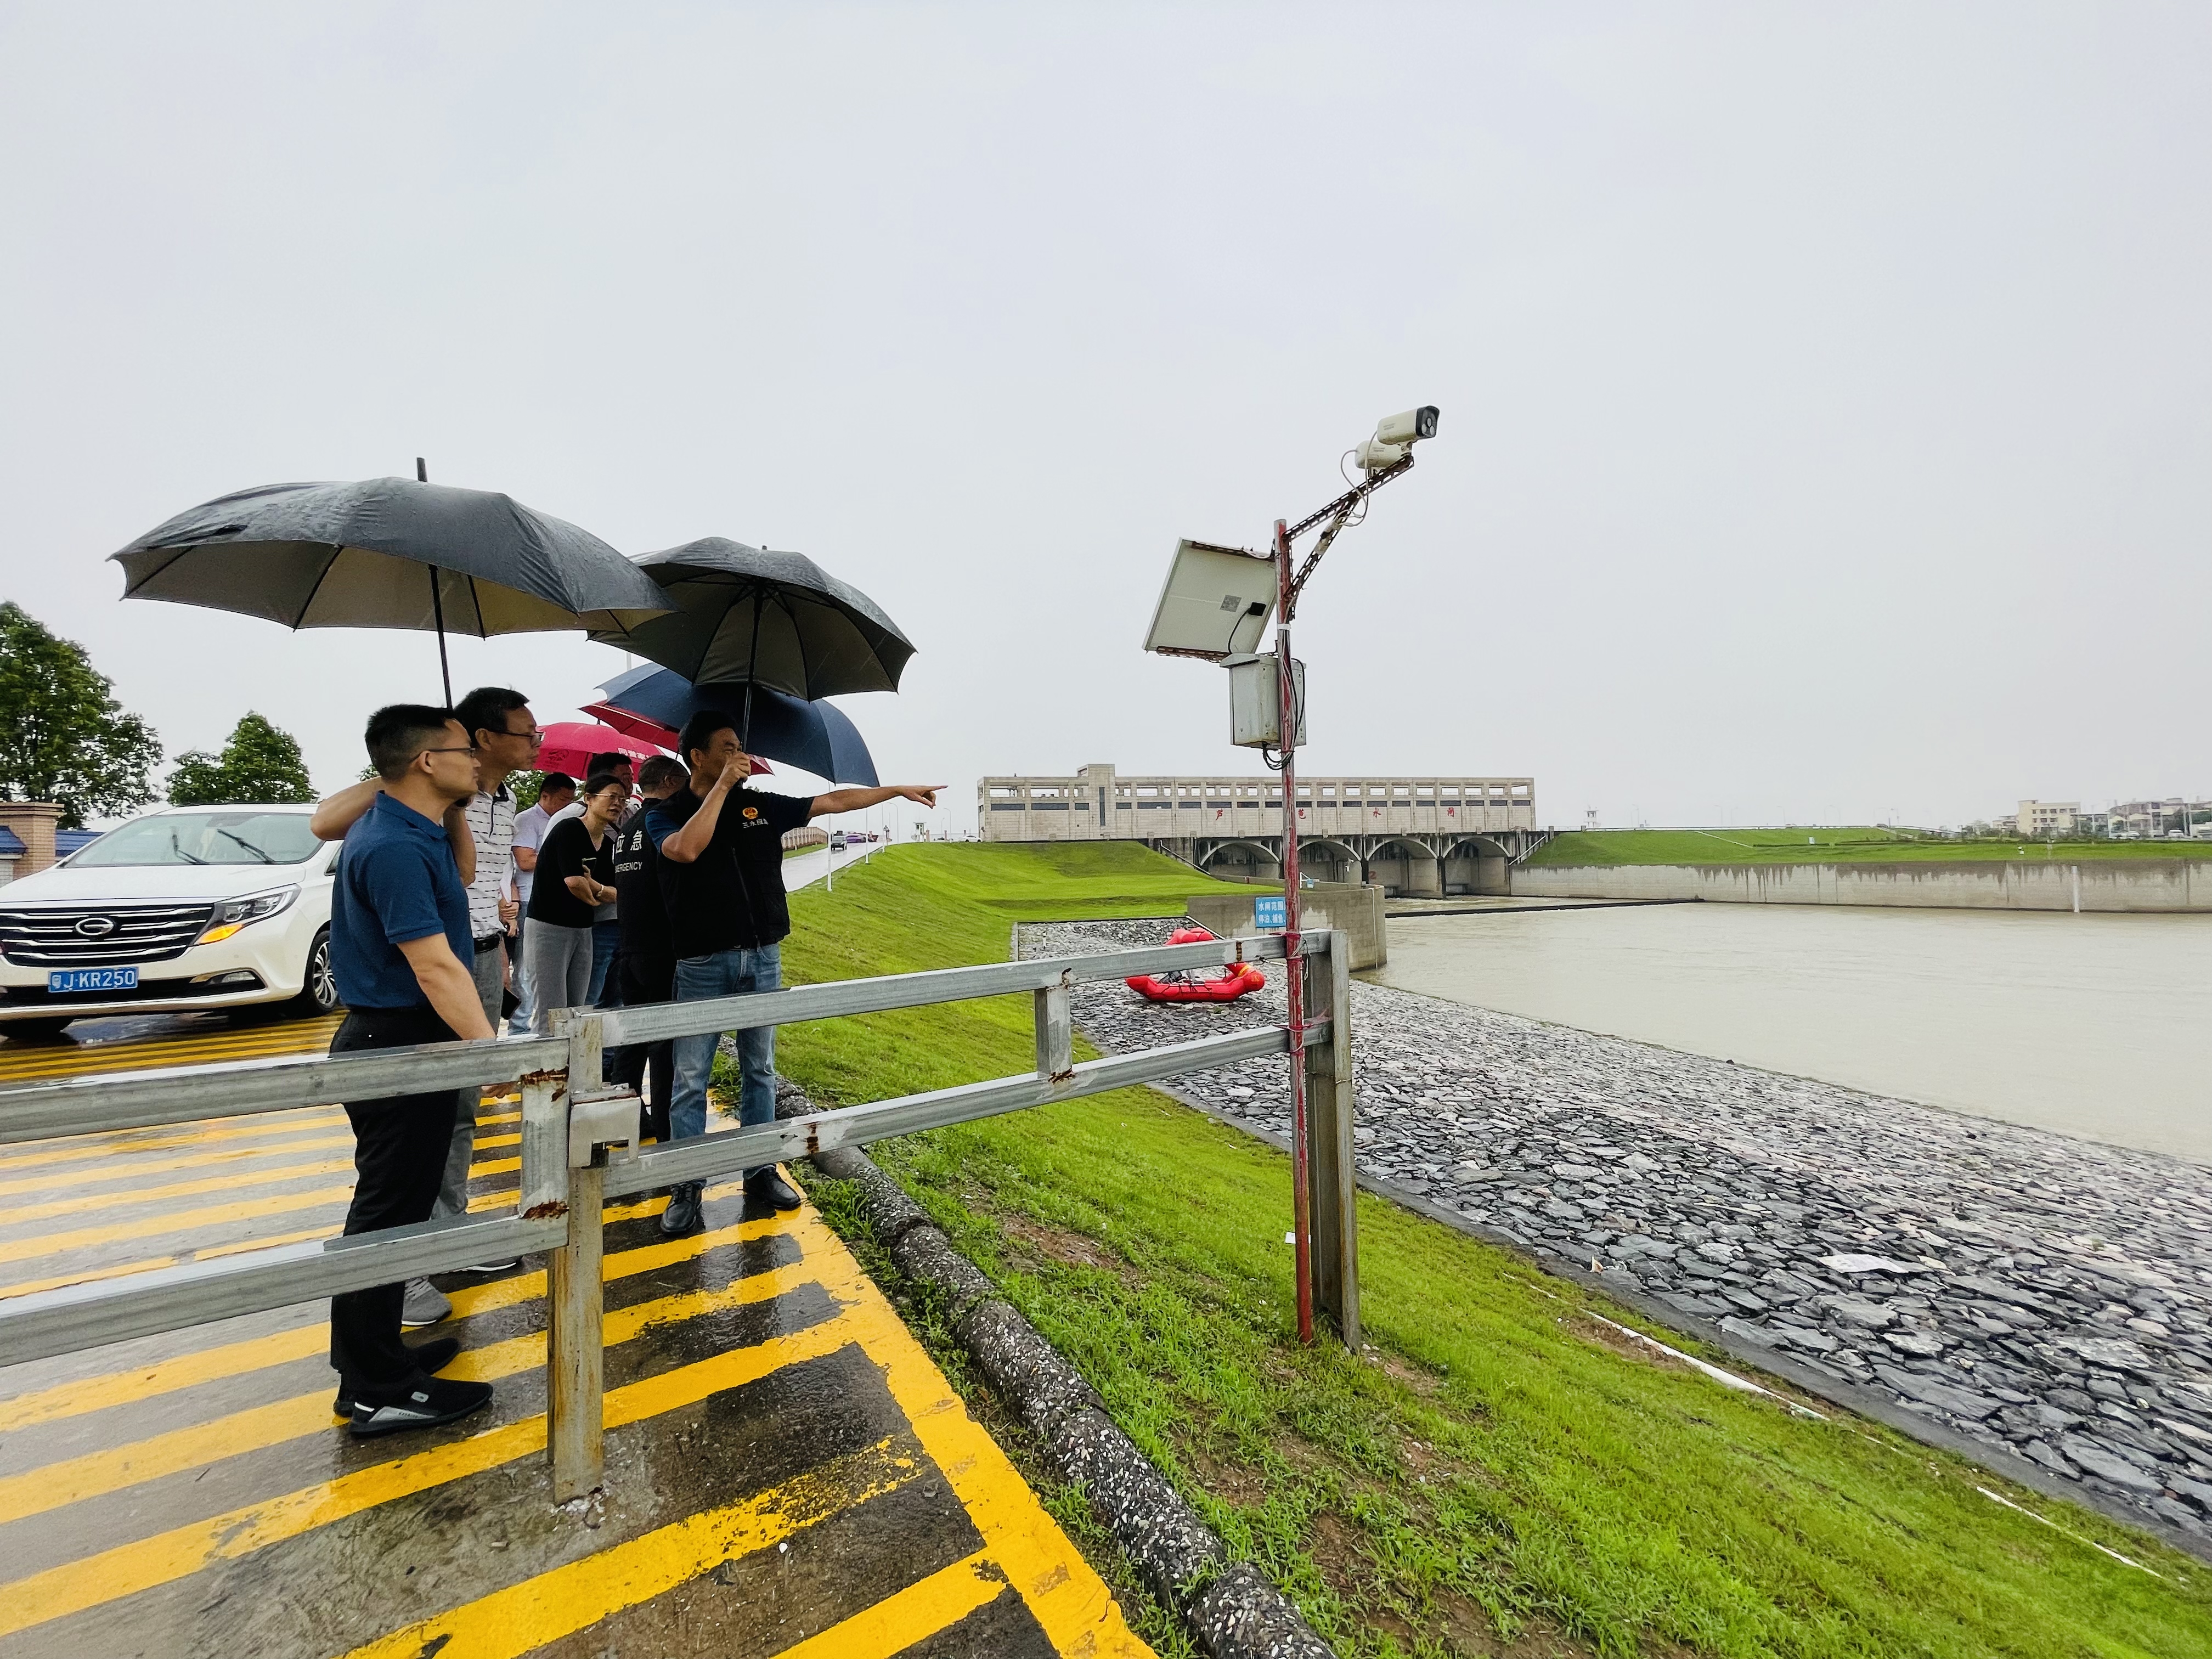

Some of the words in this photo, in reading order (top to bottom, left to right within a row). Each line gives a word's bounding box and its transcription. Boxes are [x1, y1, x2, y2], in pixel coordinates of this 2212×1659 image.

[615, 830, 642, 854] 应急
[1258, 901, 1286, 911] 水闸范围
